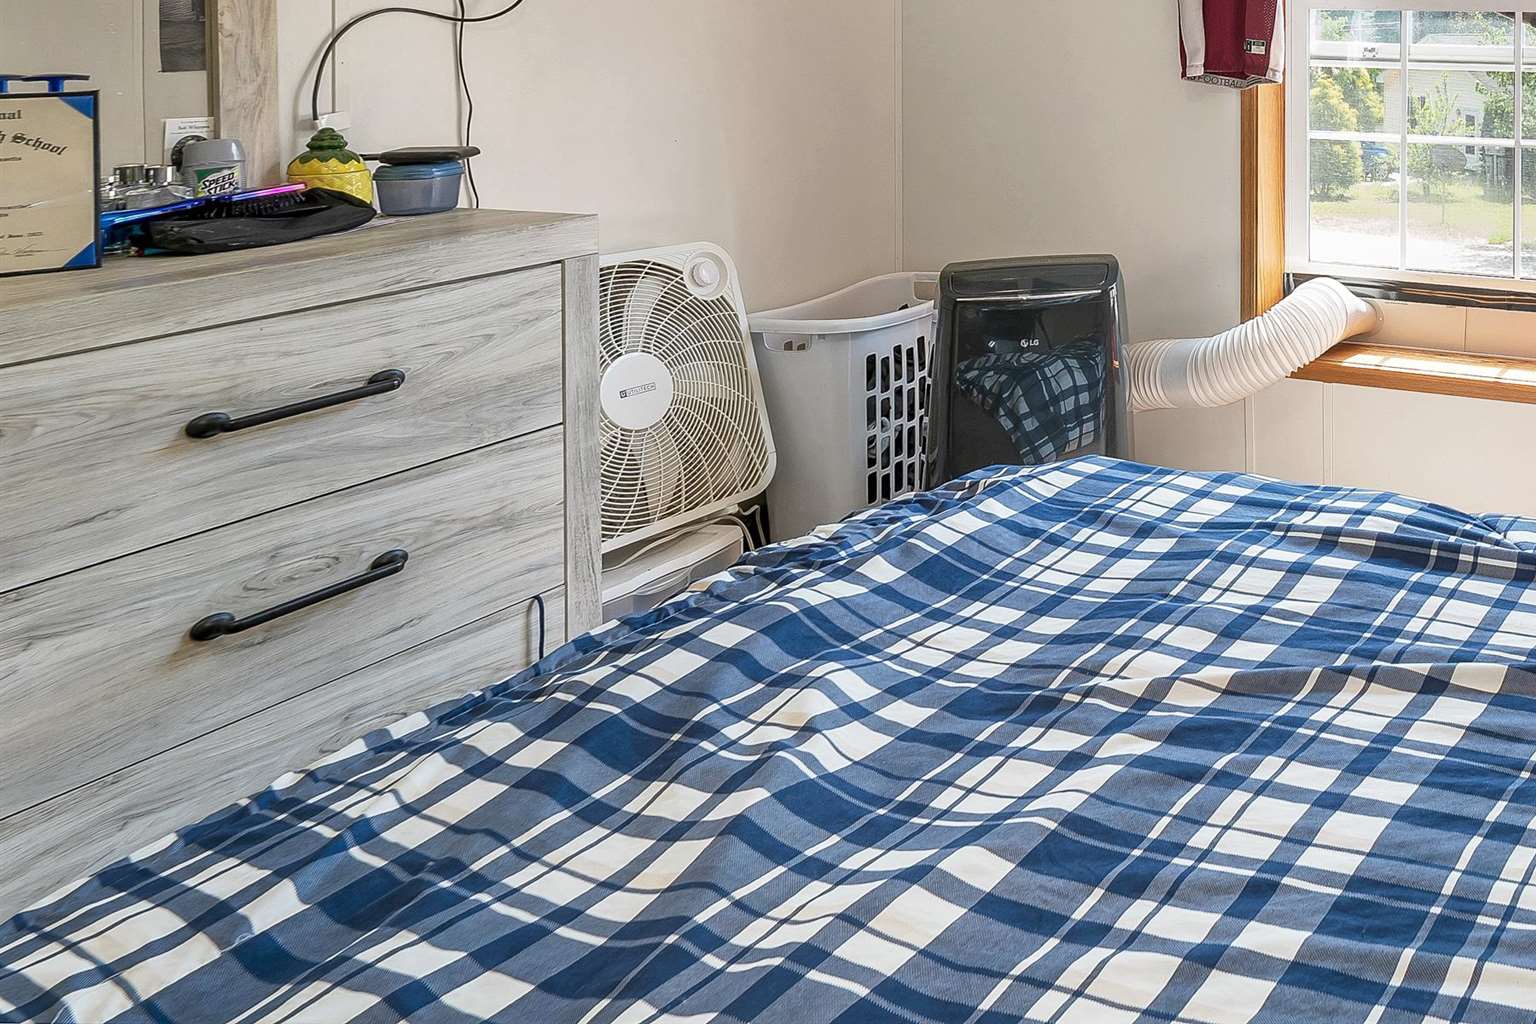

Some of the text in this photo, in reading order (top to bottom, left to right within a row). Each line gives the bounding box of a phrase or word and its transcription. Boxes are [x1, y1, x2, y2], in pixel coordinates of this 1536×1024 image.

[10, 132, 69, 155] School
[201, 172, 235, 190] SPEED
[206, 180, 236, 195] STICK
[1030, 338, 1040, 346] LG
